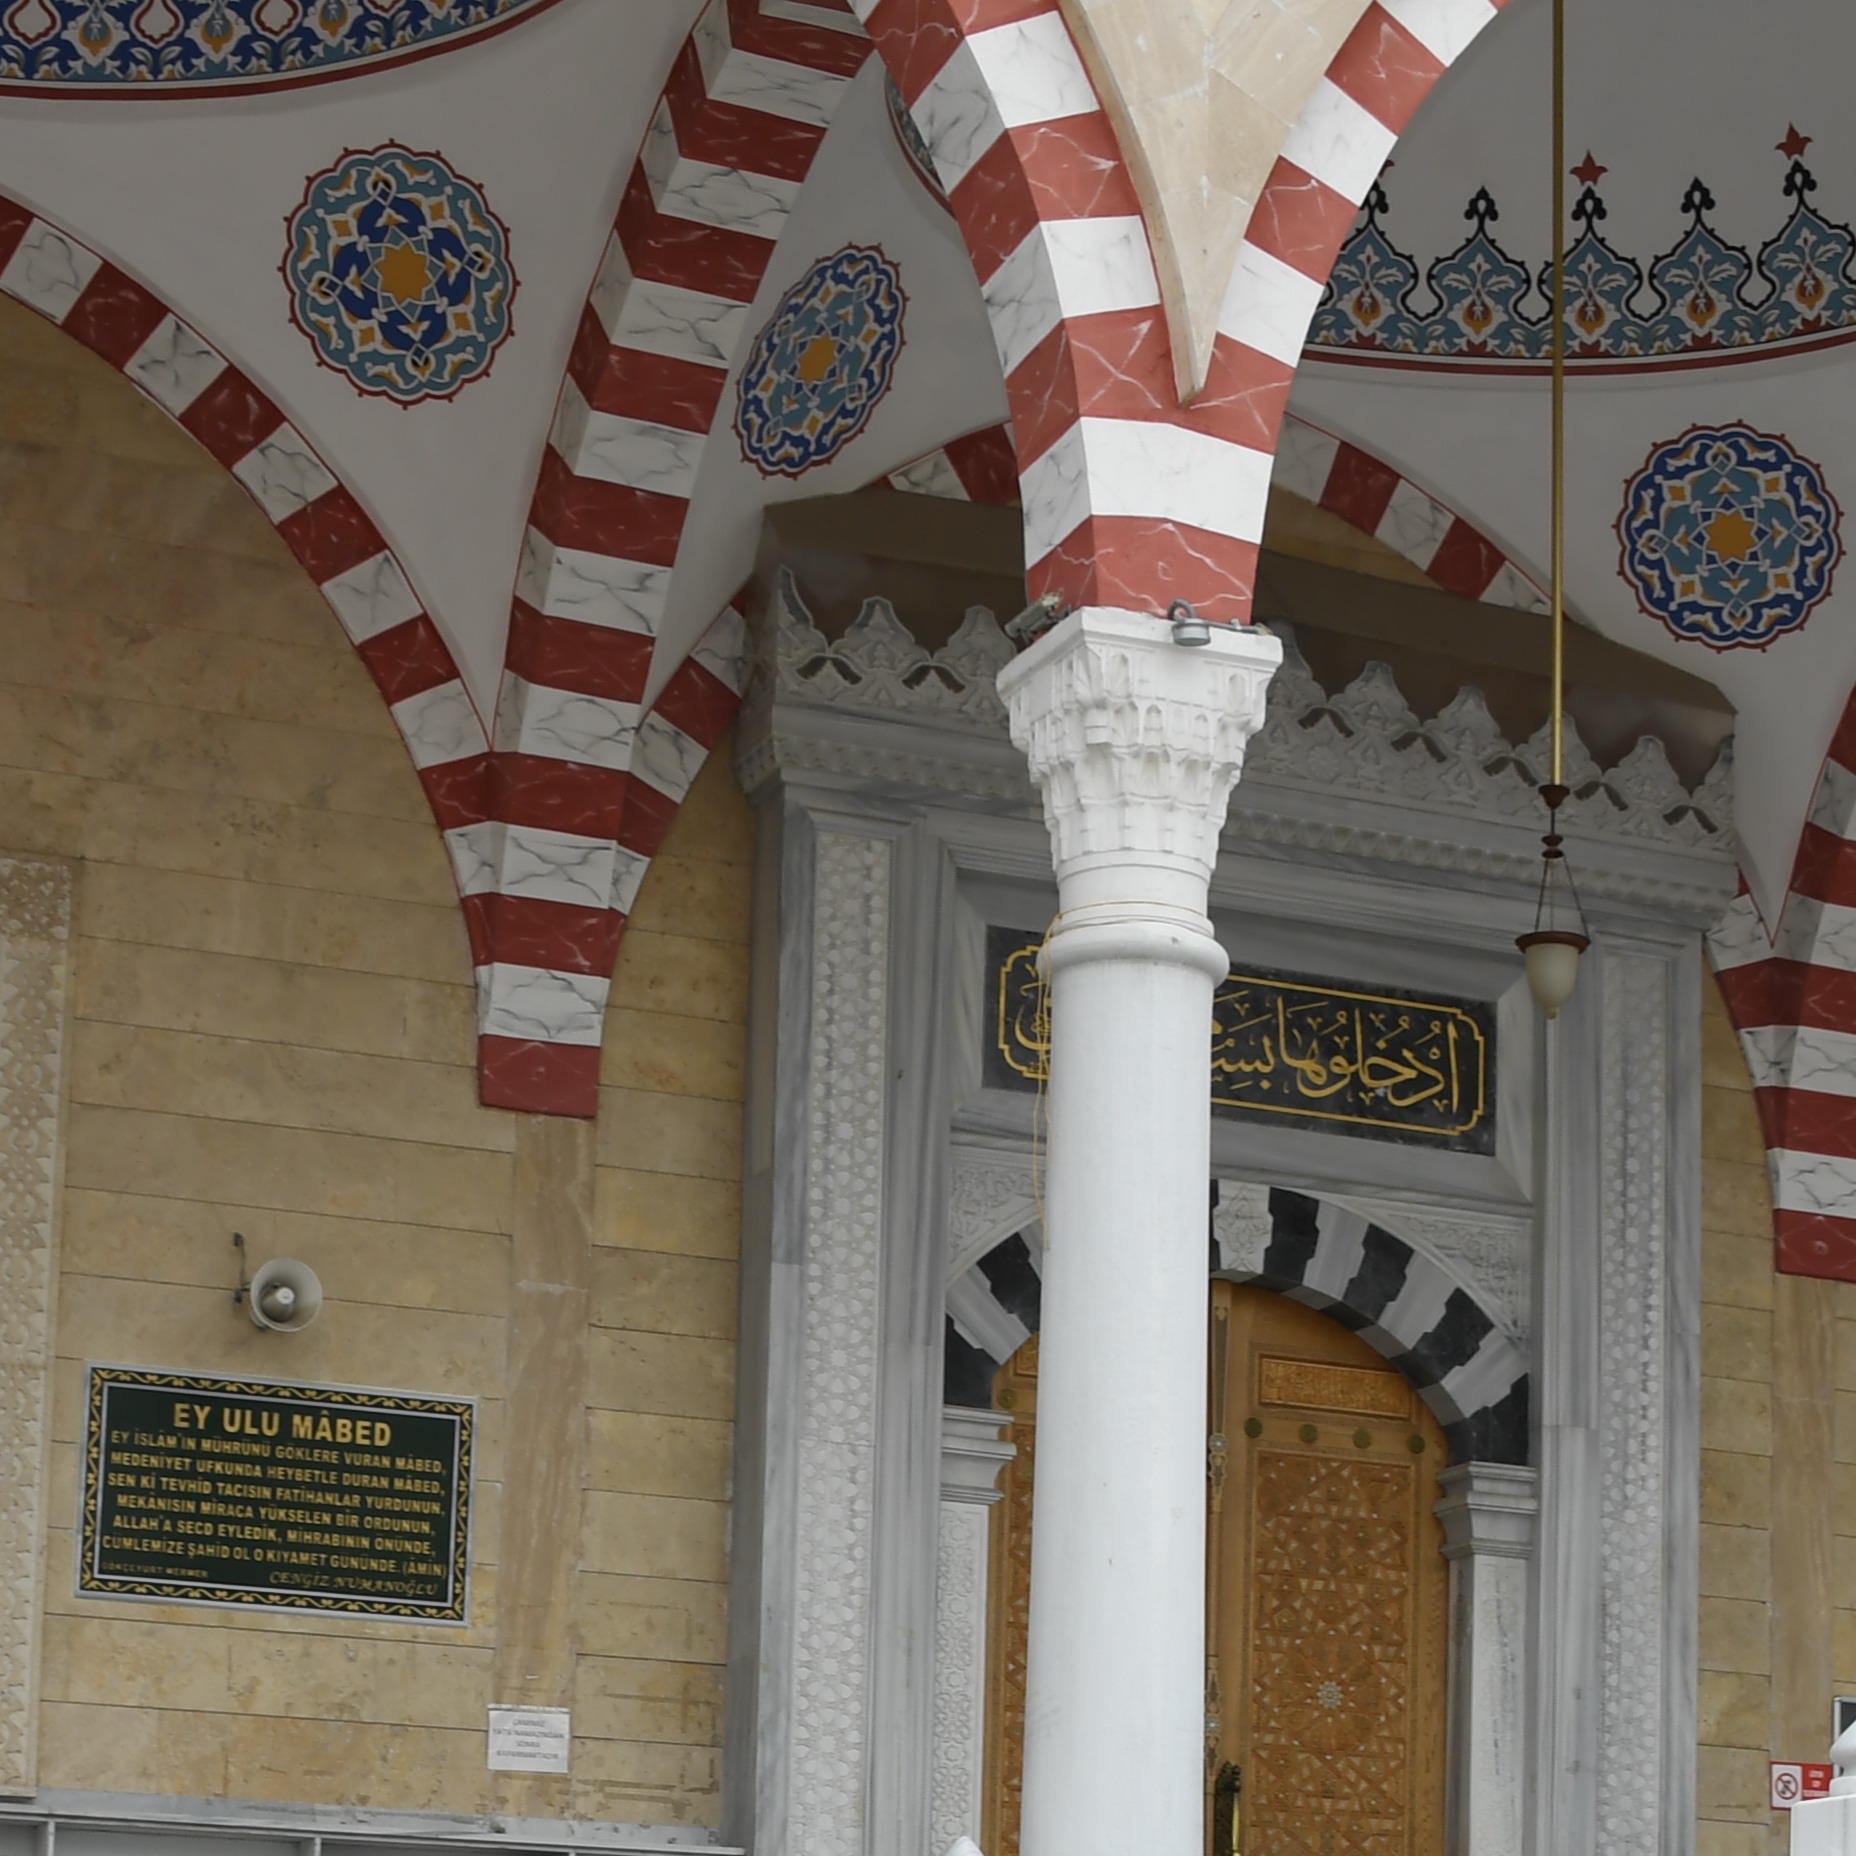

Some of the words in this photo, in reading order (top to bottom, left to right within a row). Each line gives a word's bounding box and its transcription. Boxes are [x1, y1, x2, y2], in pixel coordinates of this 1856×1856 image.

[173, 1402, 211, 1430] EY
[223, 1407, 280, 1437] ULU
[292, 1409, 392, 1447] MÂBED
[110, 1429, 129, 1444] EY
[201, 1434, 271, 1457] MÜHRÜNÜ
[275, 1442, 340, 1464] GÖKLERE
[344, 1452, 391, 1468] VURAN
[395, 1454, 447, 1476] MÂBED,
[110, 1451, 192, 1471] MEDENİYET
[196, 1459, 262, 1478] UFKUNDA
[267, 1465, 338, 1484] HEYBETLE
[342, 1472, 389, 1489] DURAN
[393, 1474, 446, 1497] MÂBED,
[107, 1473, 136, 1487] SEN
[140, 1472, 156, 1488] Kİ
[159, 1476, 212, 1494] TEVHİD
[216, 1482, 272, 1500] TACISIN
[365, 1495, 446, 1517] YURDUNUN,
[112, 1514, 173, 1532] ALLAH'A
[217, 1523, 283, 1544] EYLEDİK,
[374, 1533, 437, 1557] ÖNÜNDE,
[200, 1498, 254, 1519] MİRACA
[259, 1503, 331, 1525] YÜKSELEN
[335, 1509, 359, 1528] BİR
[363, 1516, 436, 1537] ORDUNUN,
[102, 1532, 185, 1555] CÜMLEMİZE
[187, 1541, 230, 1560] ŞAHİD
[233, 1547, 250, 1561] OL
[253, 1548, 264, 1562] O
[266, 1549, 328, 1567] KIYAMET
